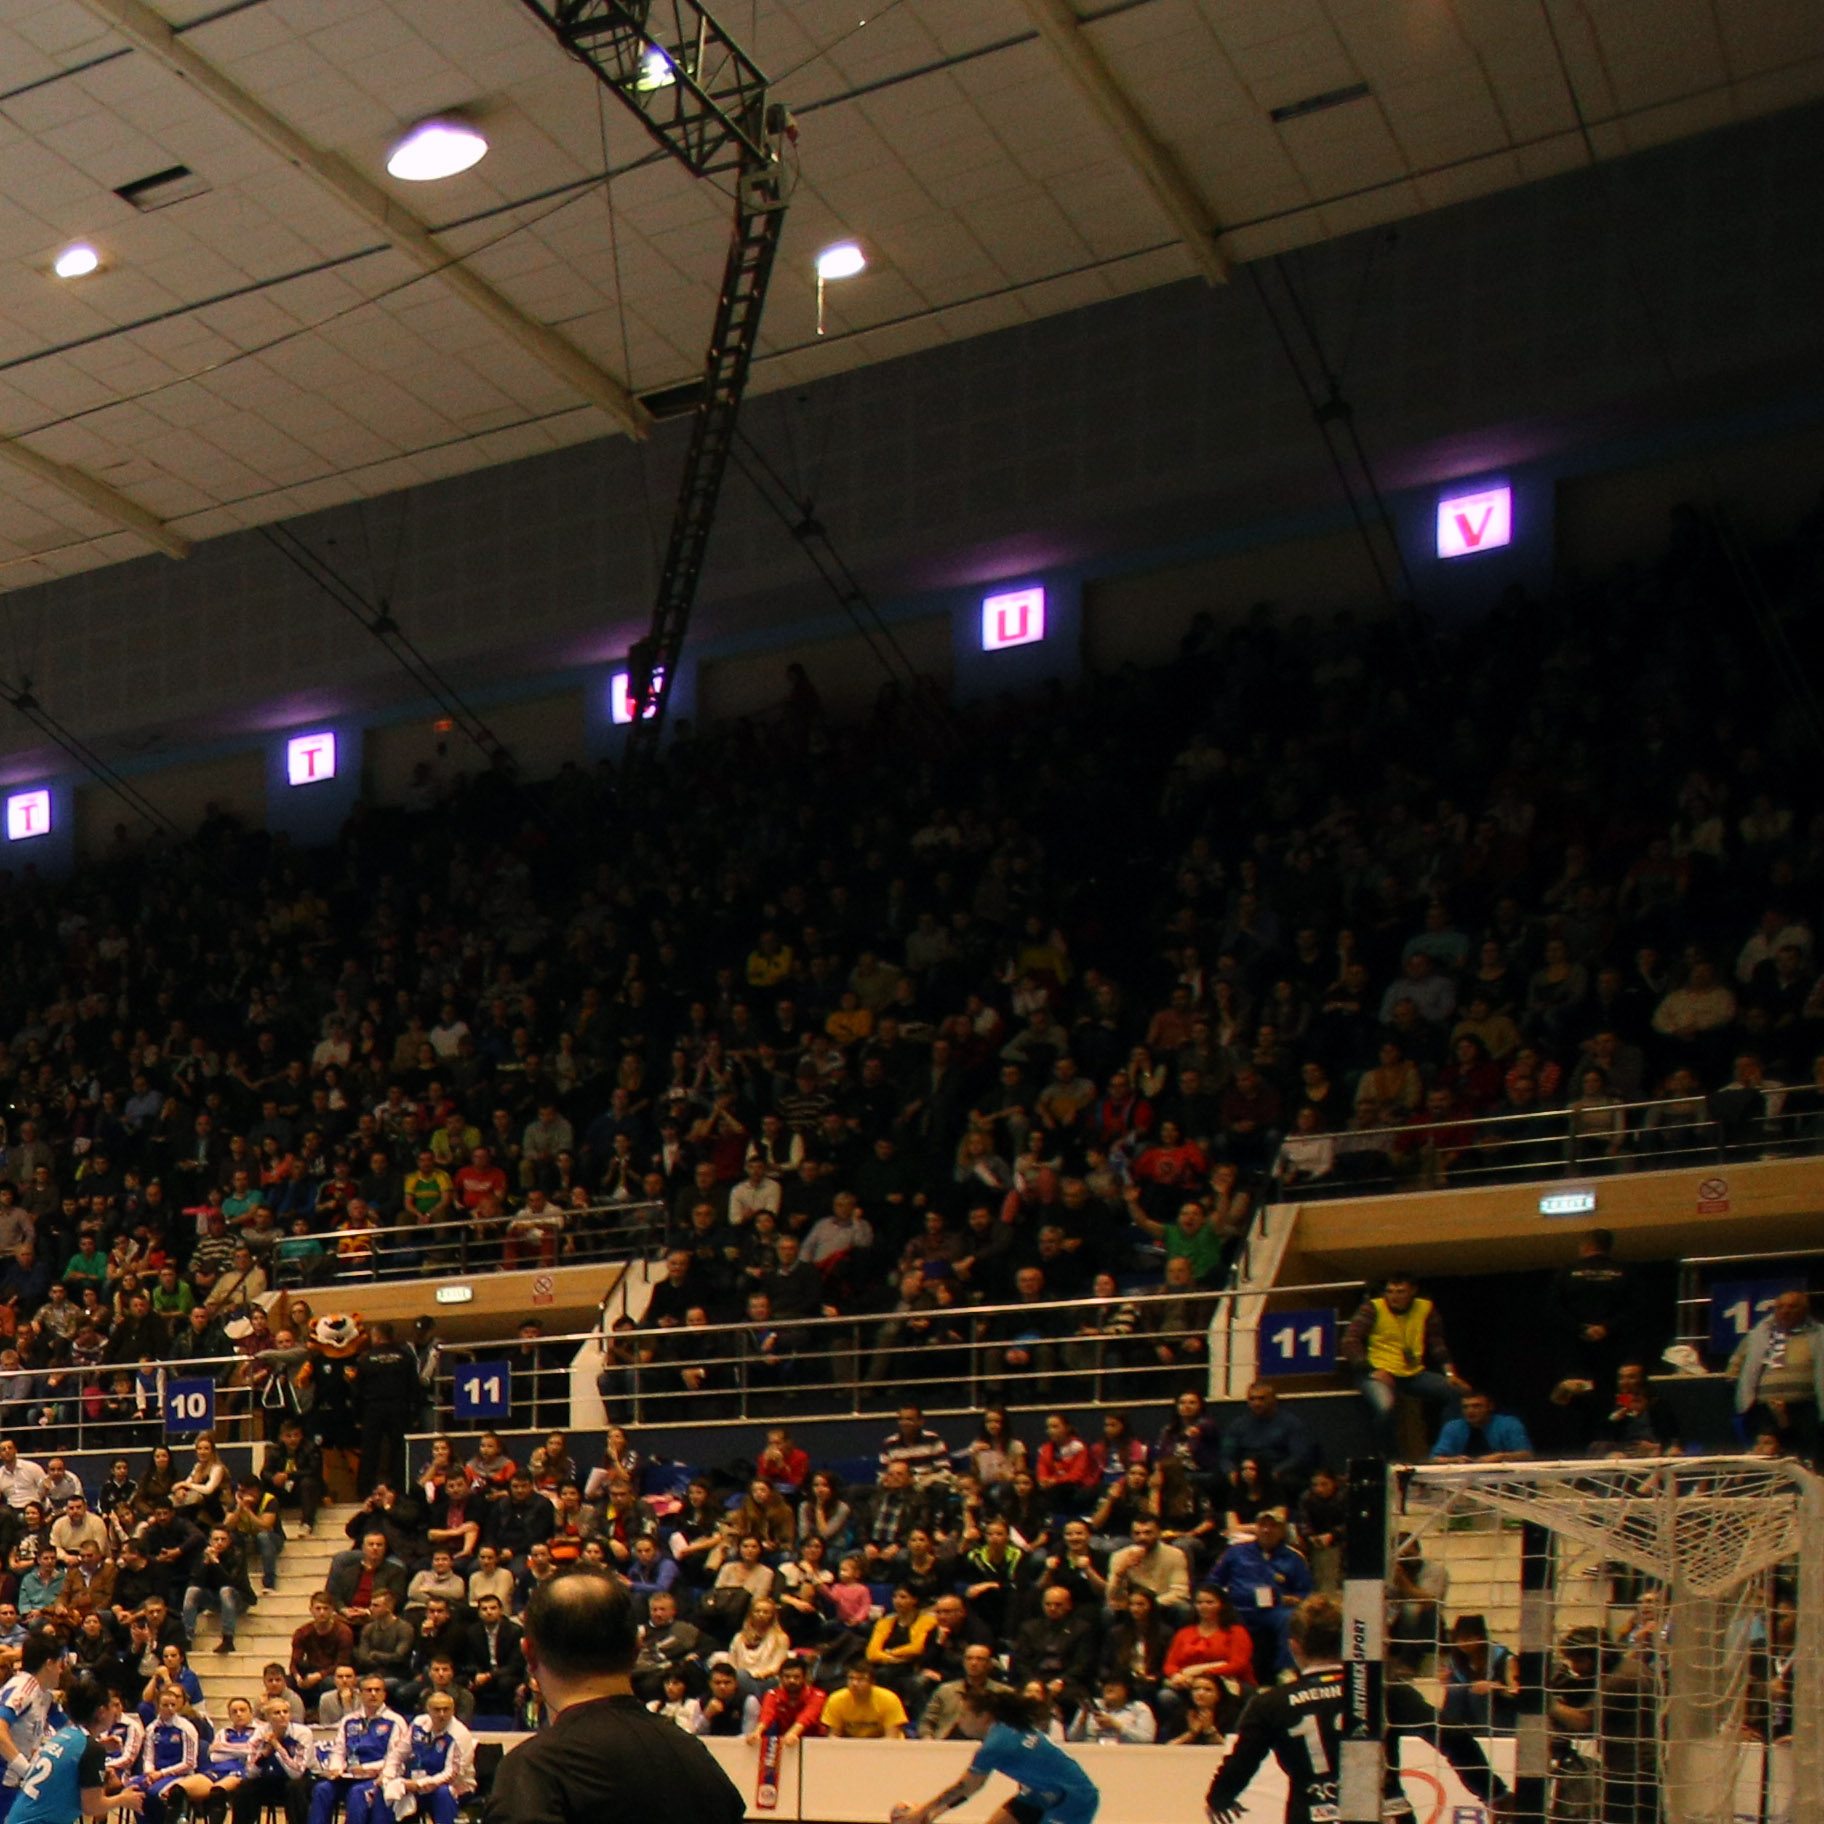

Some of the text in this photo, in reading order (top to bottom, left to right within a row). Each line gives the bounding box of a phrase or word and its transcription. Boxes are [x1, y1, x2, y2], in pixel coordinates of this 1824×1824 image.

[1454, 506, 1494, 548] V
[997, 604, 1028, 642] U
[300, 747, 322, 777] T
[19, 804, 38, 831] T
[1271, 1326, 1323, 1358] 11
[170, 1393, 206, 1419] 10
[463, 1376, 500, 1404] 11
[1353, 1618, 1365, 1660] SPORT
[1287, 1713, 1343, 1774] 1
